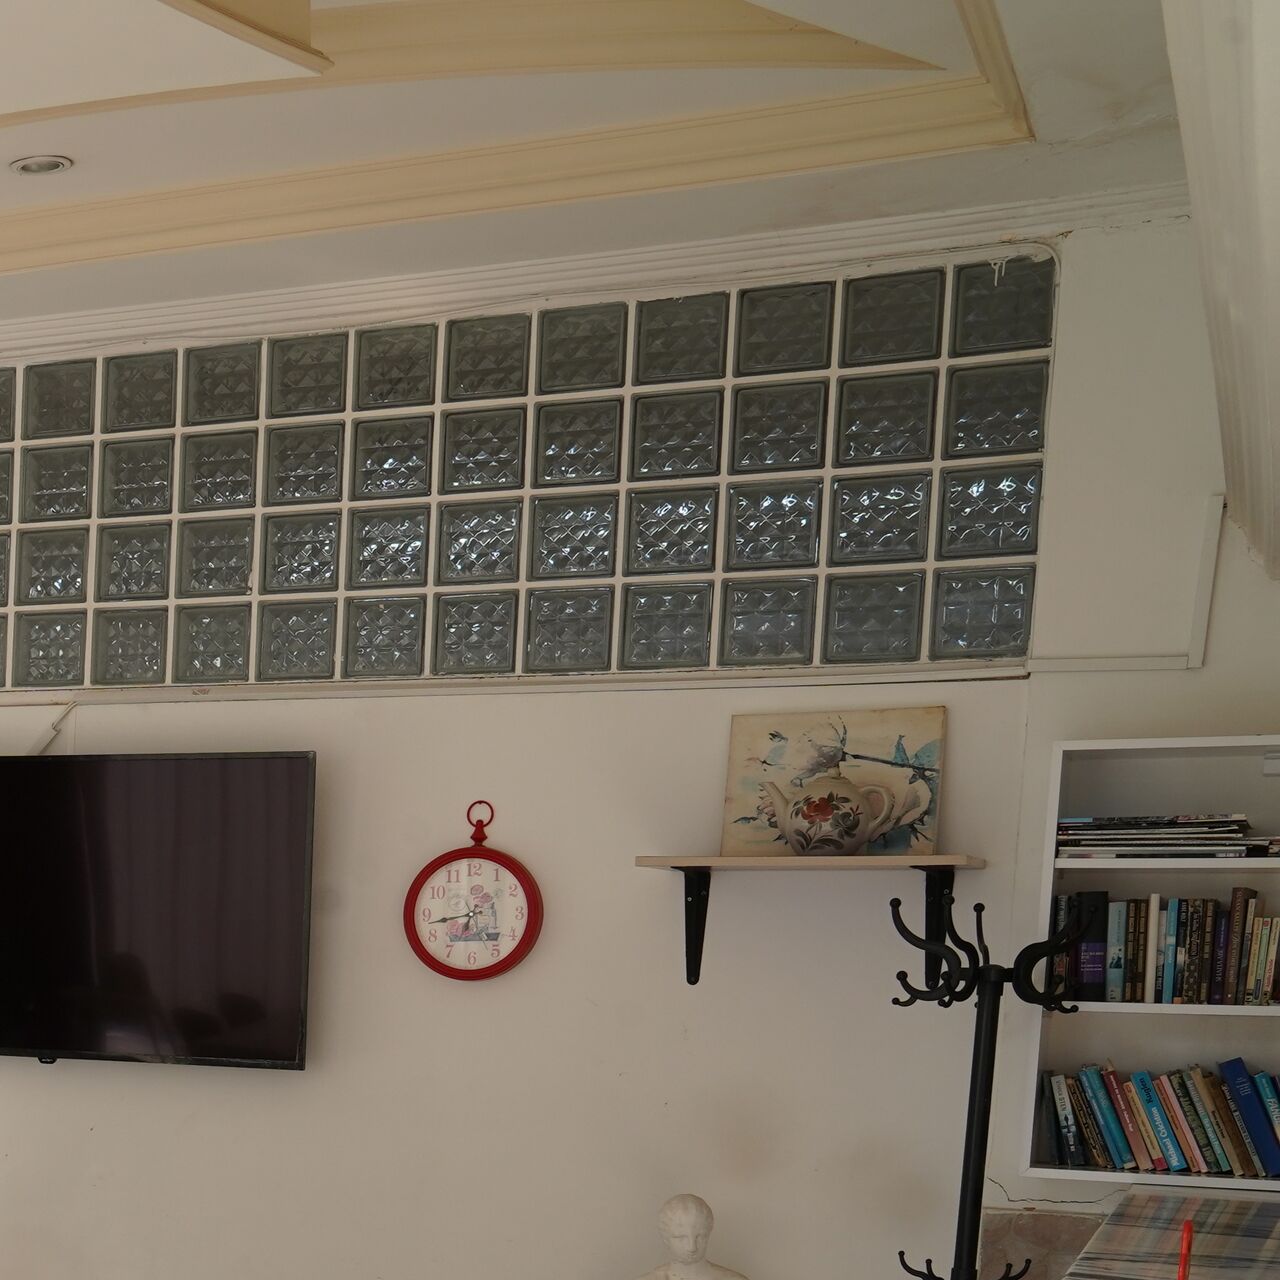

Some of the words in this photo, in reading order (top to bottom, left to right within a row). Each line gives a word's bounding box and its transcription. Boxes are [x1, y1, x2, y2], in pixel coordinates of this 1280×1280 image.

[445, 869, 461, 883] 11
[466, 863, 482, 877] 12
[493, 868, 500, 882] 1
[430, 885, 445, 900] 10
[509, 883, 518, 897] 2
[422, 907, 431, 922] 9
[515, 906, 525, 921] 3
[428, 928, 437, 943] 8
[507, 927, 518, 941] 4
[445, 944, 453, 959] 7
[467, 951, 477, 966] 6
[490, 944, 500, 959] 5
[1139, 1077, 1155, 1104] Kuglen
